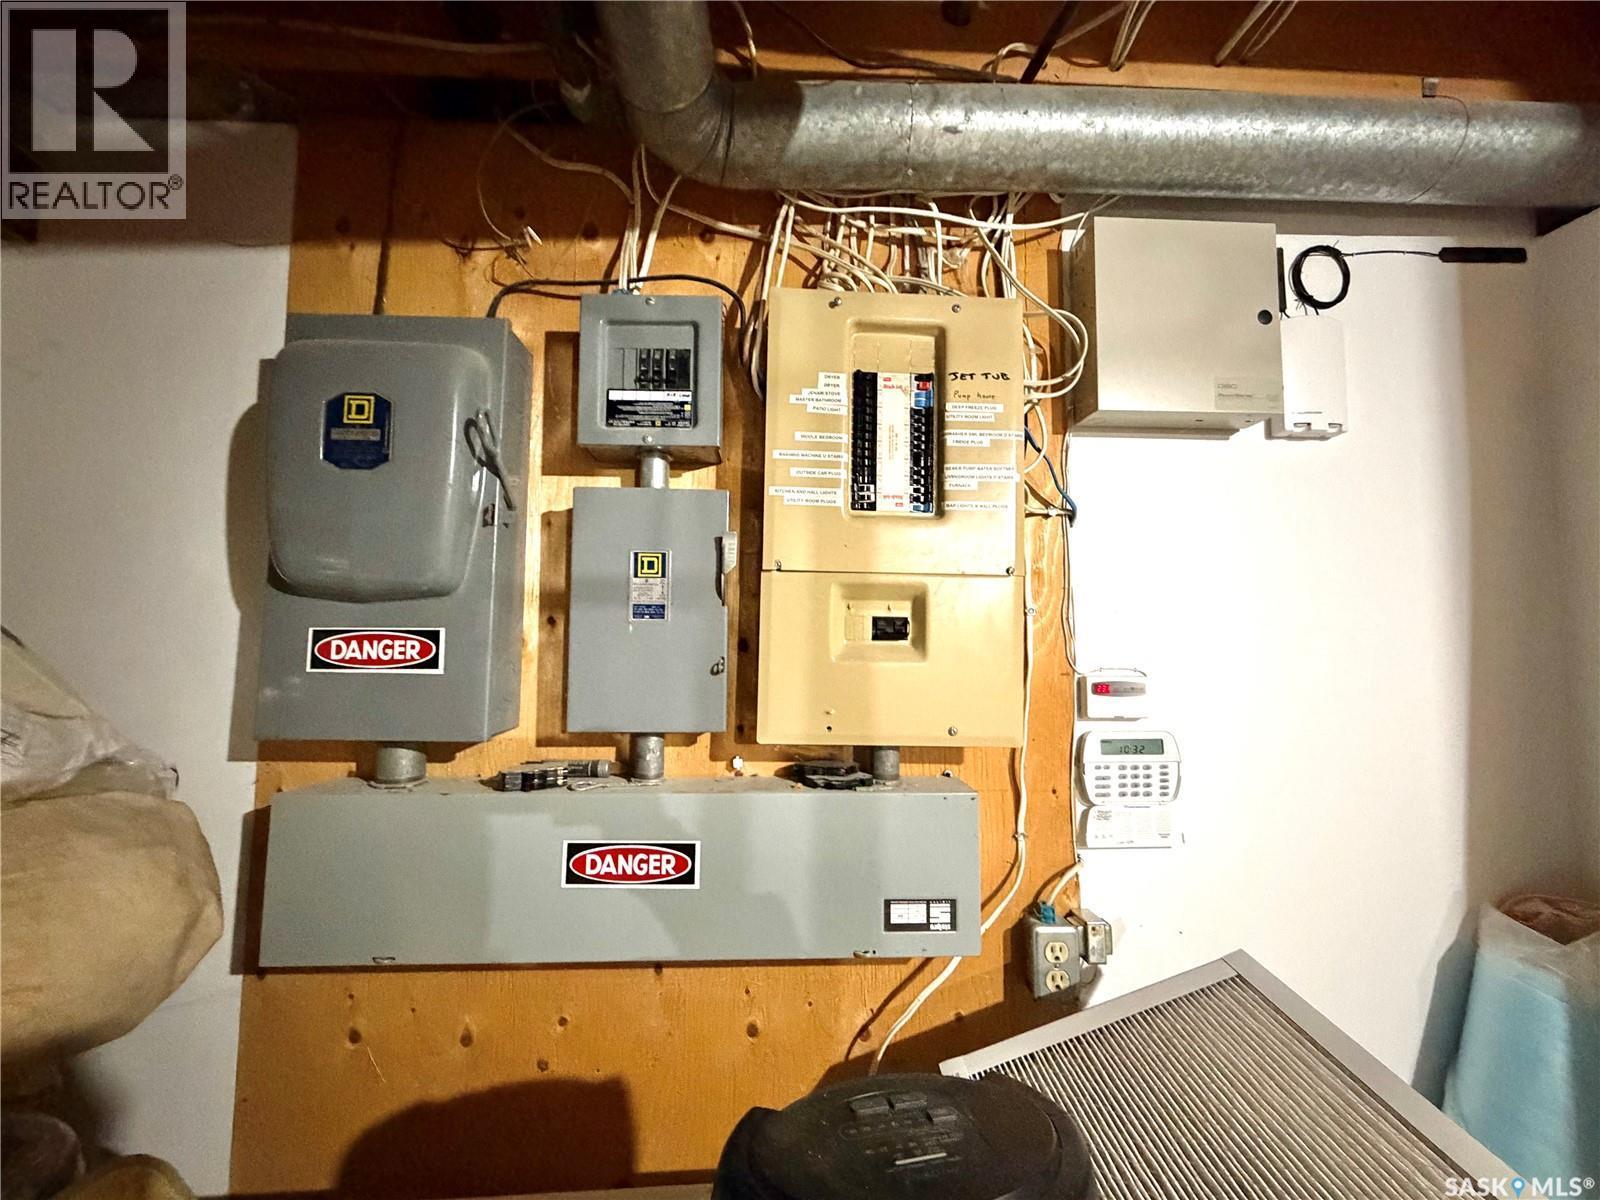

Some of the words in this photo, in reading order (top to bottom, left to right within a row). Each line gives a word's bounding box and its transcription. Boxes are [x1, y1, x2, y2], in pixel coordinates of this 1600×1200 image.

[948, 372, 976, 381] JET
[980, 372, 1010, 381] TUB
[953, 390, 971, 401] Pump
[330, 639, 421, 661] DANGER
[1119, 744, 1146, 755] 10:32
[585, 853, 677, 876] DANGER
